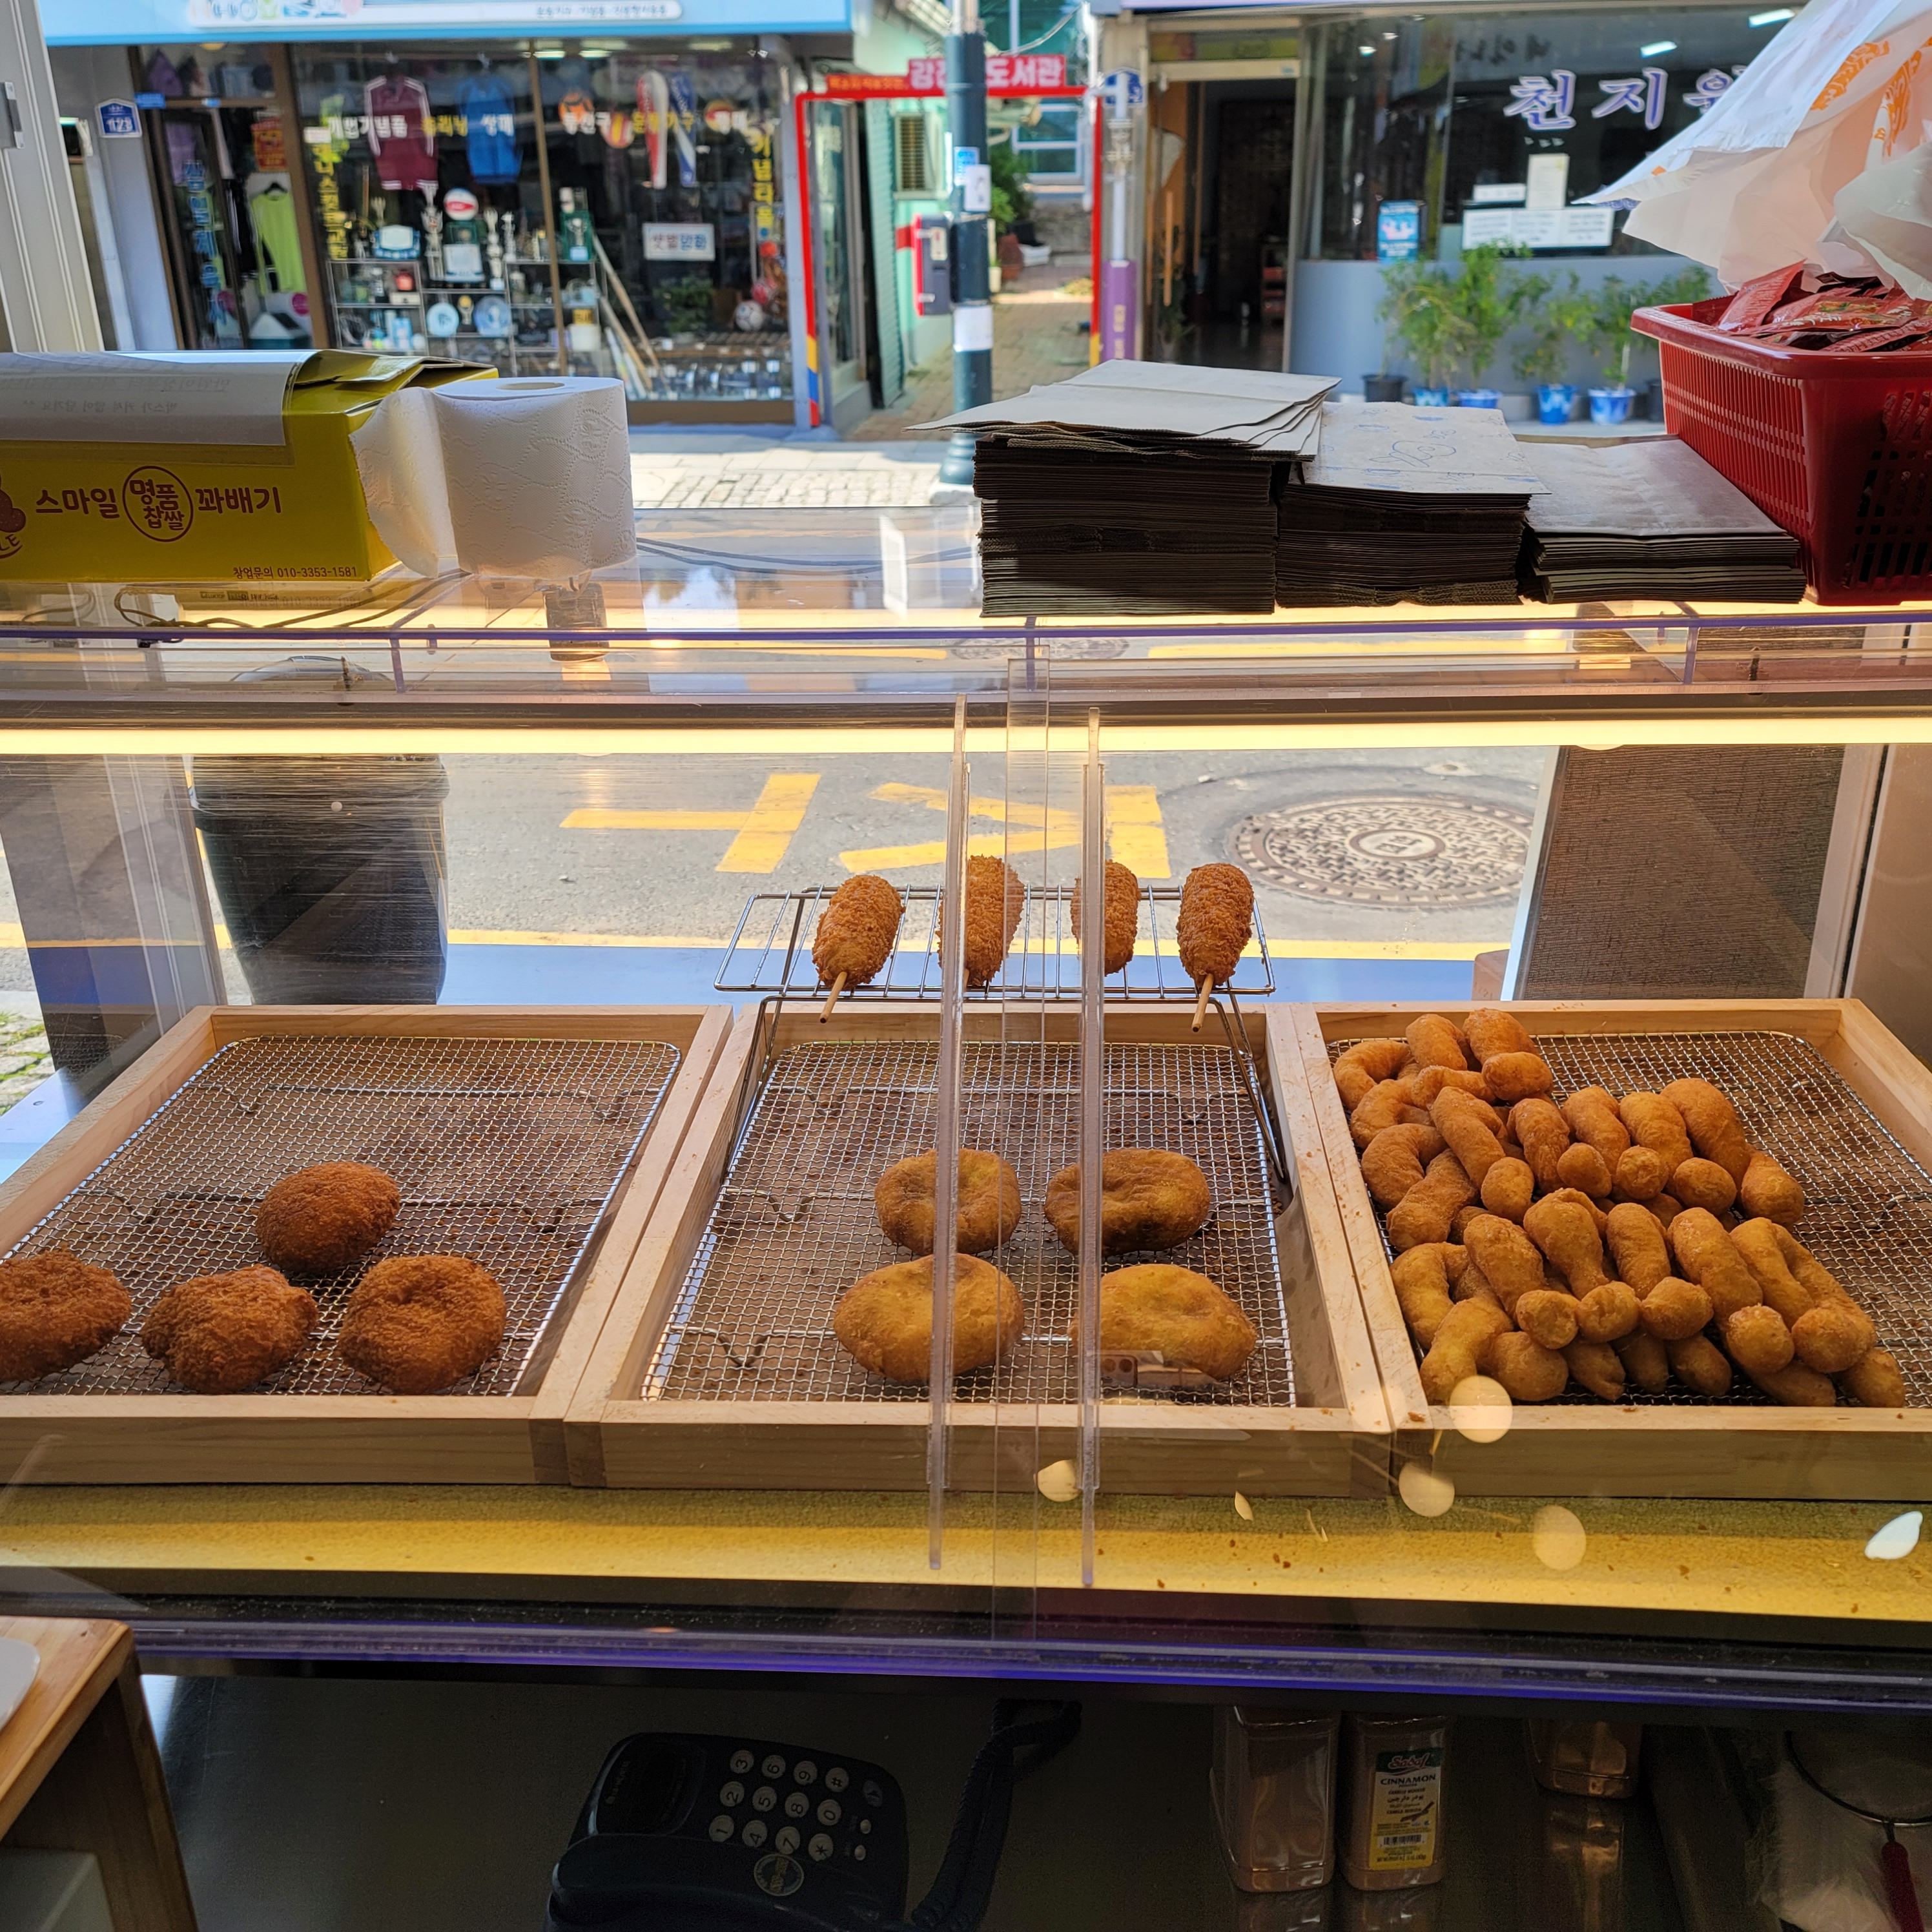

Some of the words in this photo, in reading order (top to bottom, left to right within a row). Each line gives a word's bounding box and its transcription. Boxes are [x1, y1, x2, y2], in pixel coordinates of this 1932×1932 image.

[105, 116, 133, 132] 123
[36, 488, 120, 519] 스마일
[194, 486, 282, 515] 꽈배기
[129, 478, 179, 511] 명품
[142, 505, 185, 531] 찹쌀
[232, 566, 274, 580] 창업문의
[276, 566, 358, 579] 010-3353-1581
[1380, 1774, 1437, 1786] CINNAMON
